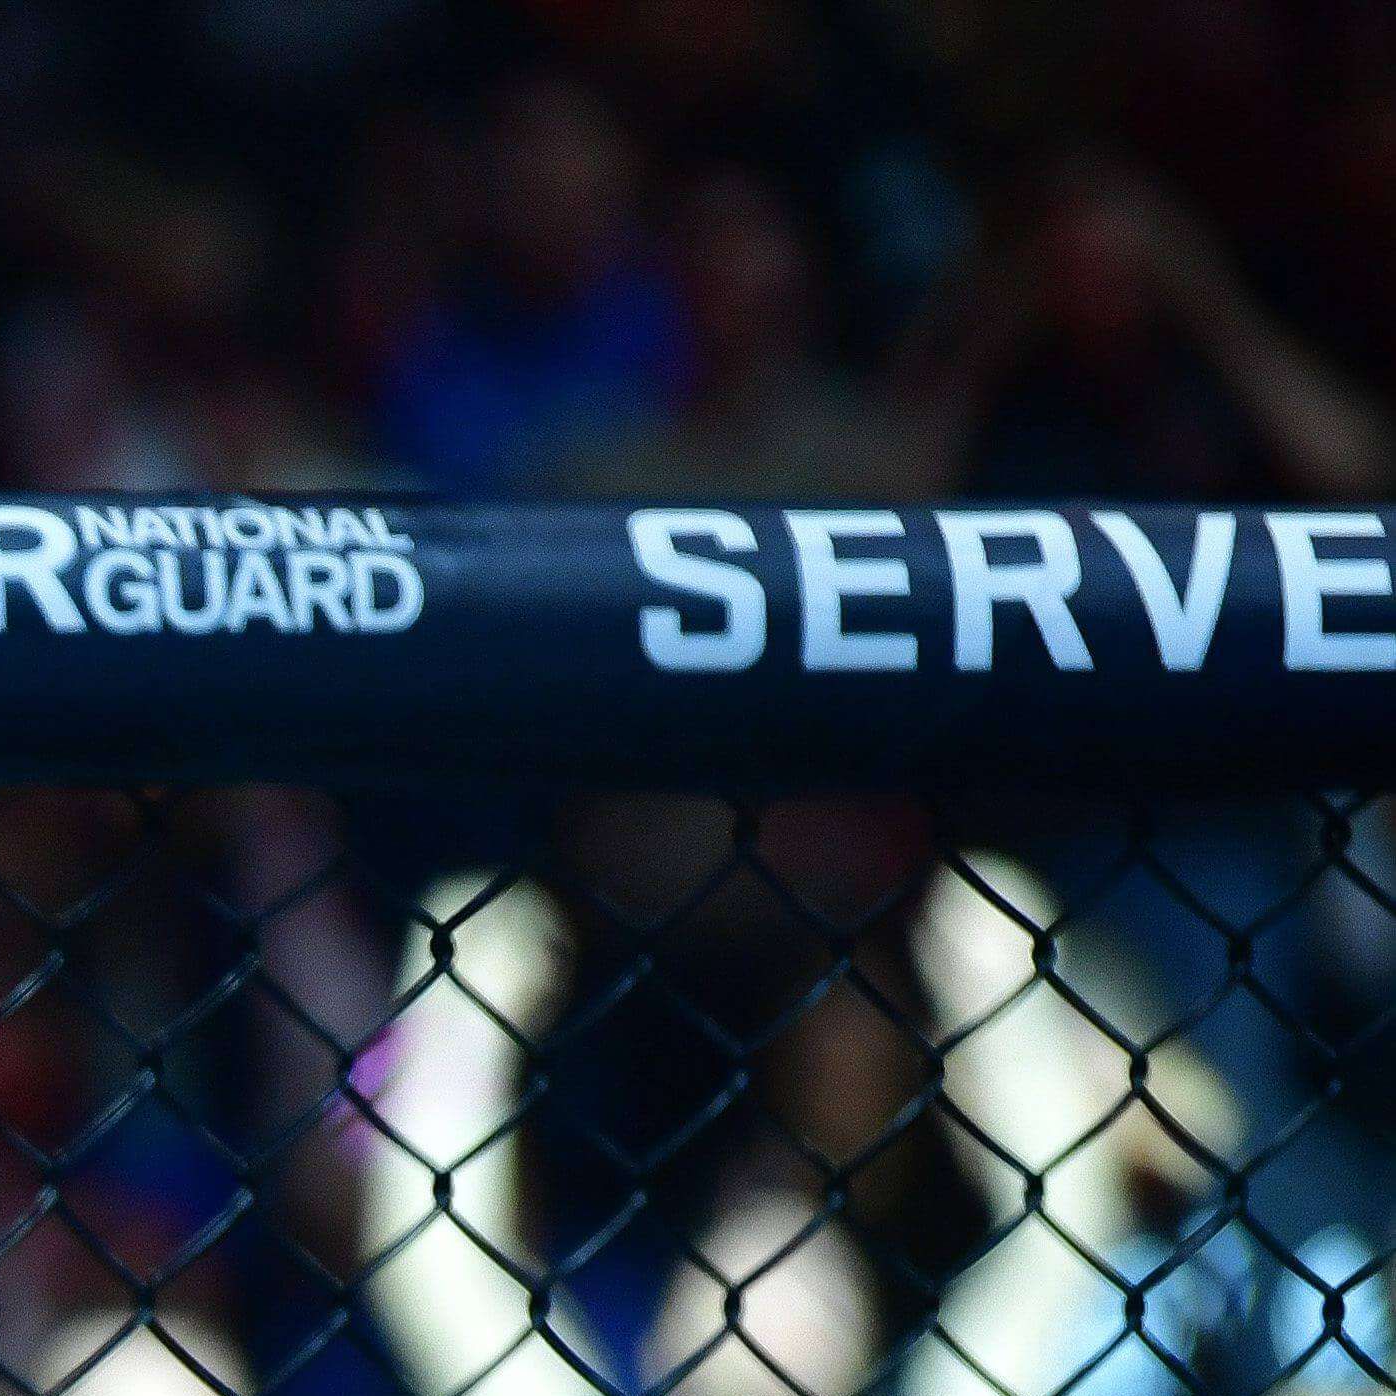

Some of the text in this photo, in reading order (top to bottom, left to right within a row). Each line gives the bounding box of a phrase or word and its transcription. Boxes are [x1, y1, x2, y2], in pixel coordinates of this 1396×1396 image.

[75, 503, 415, 552] NATIONAL
[83, 548, 425, 635] GUARD
[626, 507, 1396, 671] SERVE
